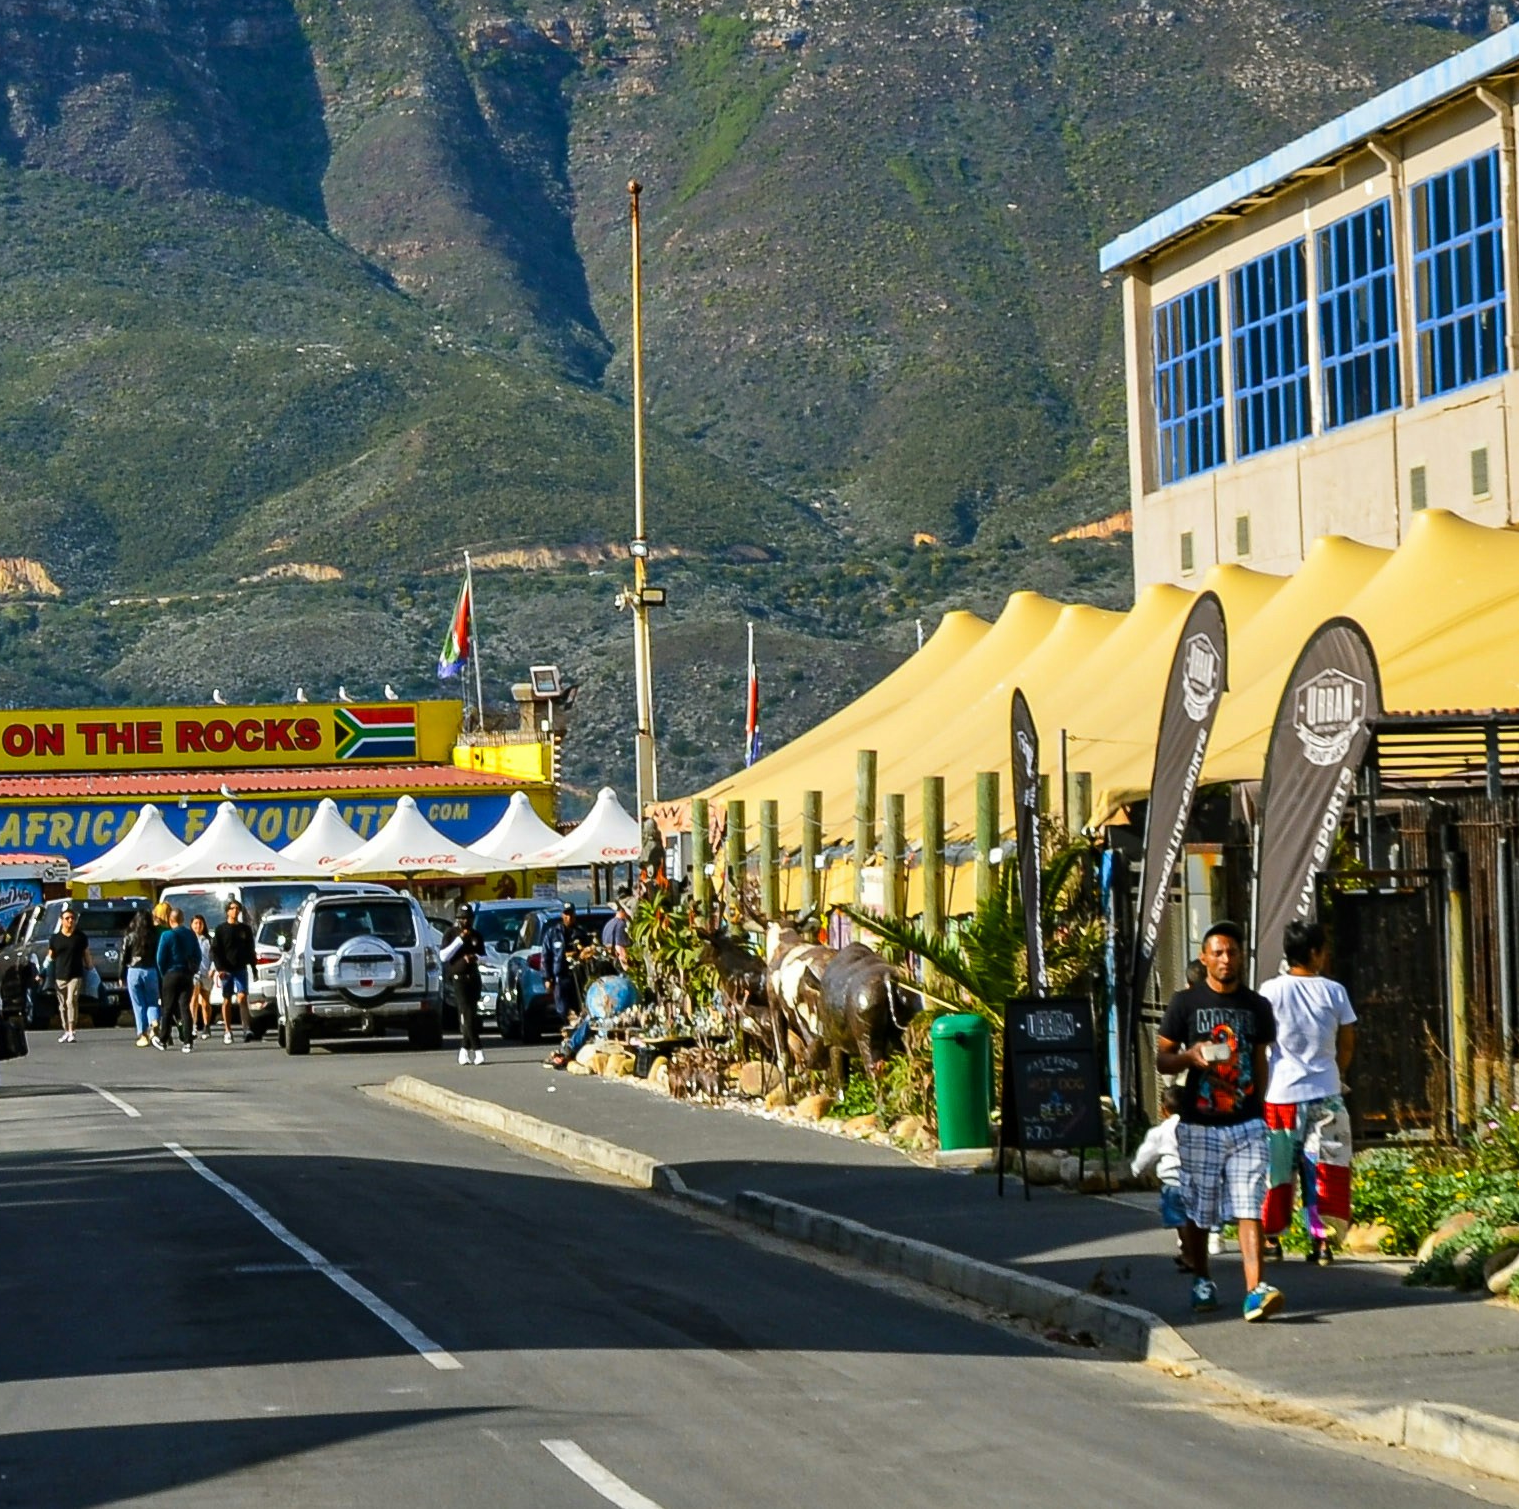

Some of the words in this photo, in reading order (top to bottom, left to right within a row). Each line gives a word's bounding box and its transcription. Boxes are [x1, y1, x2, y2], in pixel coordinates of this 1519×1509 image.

[2, 723, 65, 757] ON
[76, 721, 164, 755] THE
[176, 718, 322, 753] ROCKS
